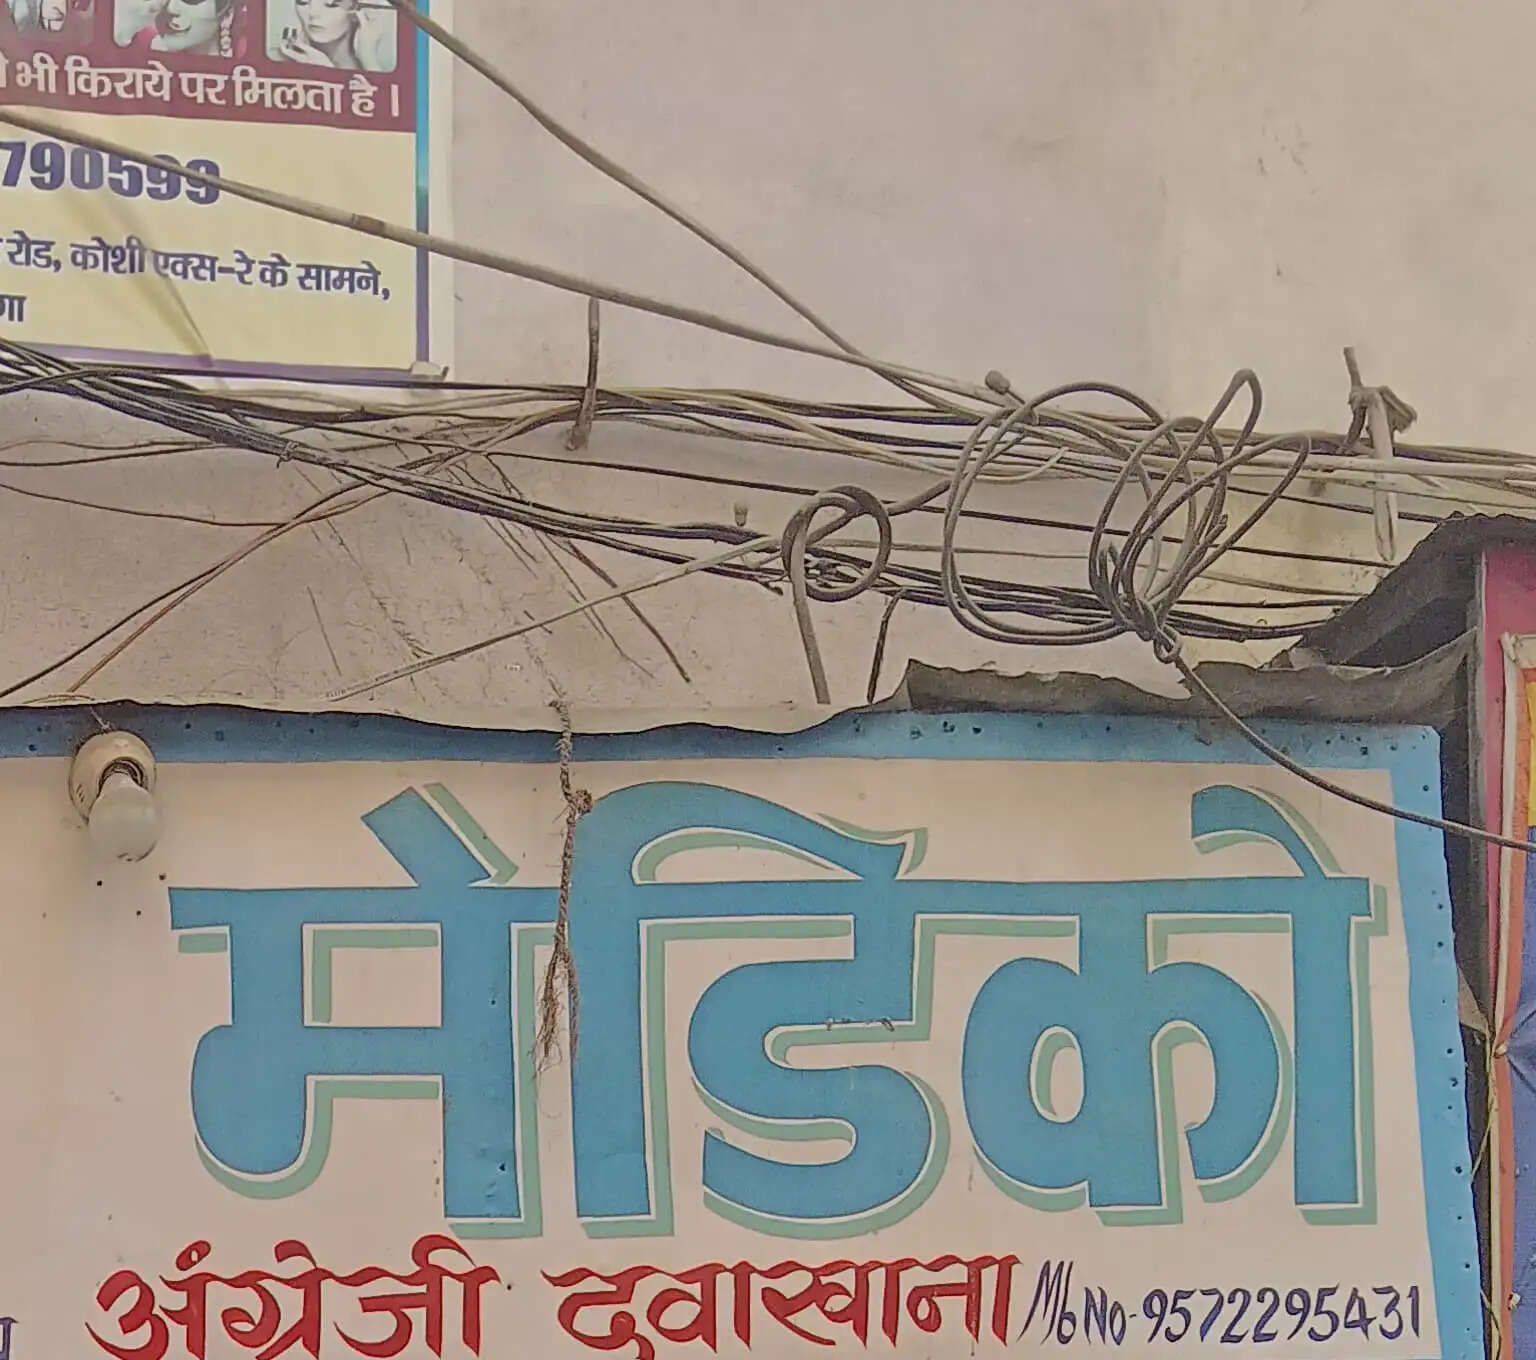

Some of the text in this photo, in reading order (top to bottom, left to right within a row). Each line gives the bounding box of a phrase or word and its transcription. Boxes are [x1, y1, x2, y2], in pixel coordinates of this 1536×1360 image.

[15, 52, 58, 95] भी
[64, 55, 174, 101] किराये
[178, 72, 233, 106] पर
[231, 65, 344, 115] मिलता
[350, 73, 378, 118] है
[5, 230, 63, 273] रोड,
[70, 234, 147, 275] कोशी
[258, 252, 292, 290] के
[296, 260, 391, 301] सामने,
[168, 781, 1388, 1238] मेडिको
